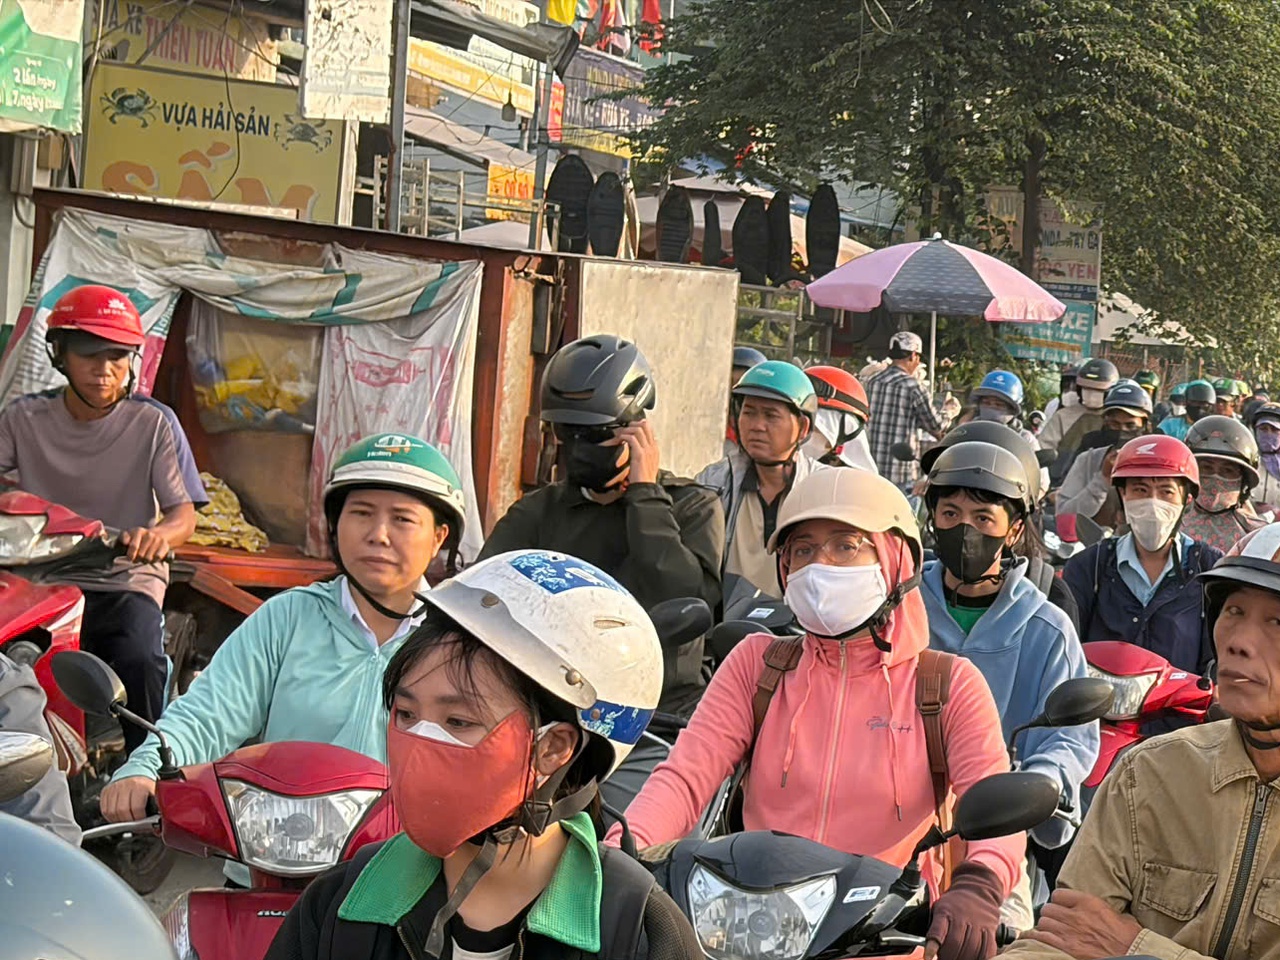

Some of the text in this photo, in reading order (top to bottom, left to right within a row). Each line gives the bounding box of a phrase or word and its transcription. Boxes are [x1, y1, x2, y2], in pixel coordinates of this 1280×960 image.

[162, 101, 270, 136] VỰA HẢI SẢN
